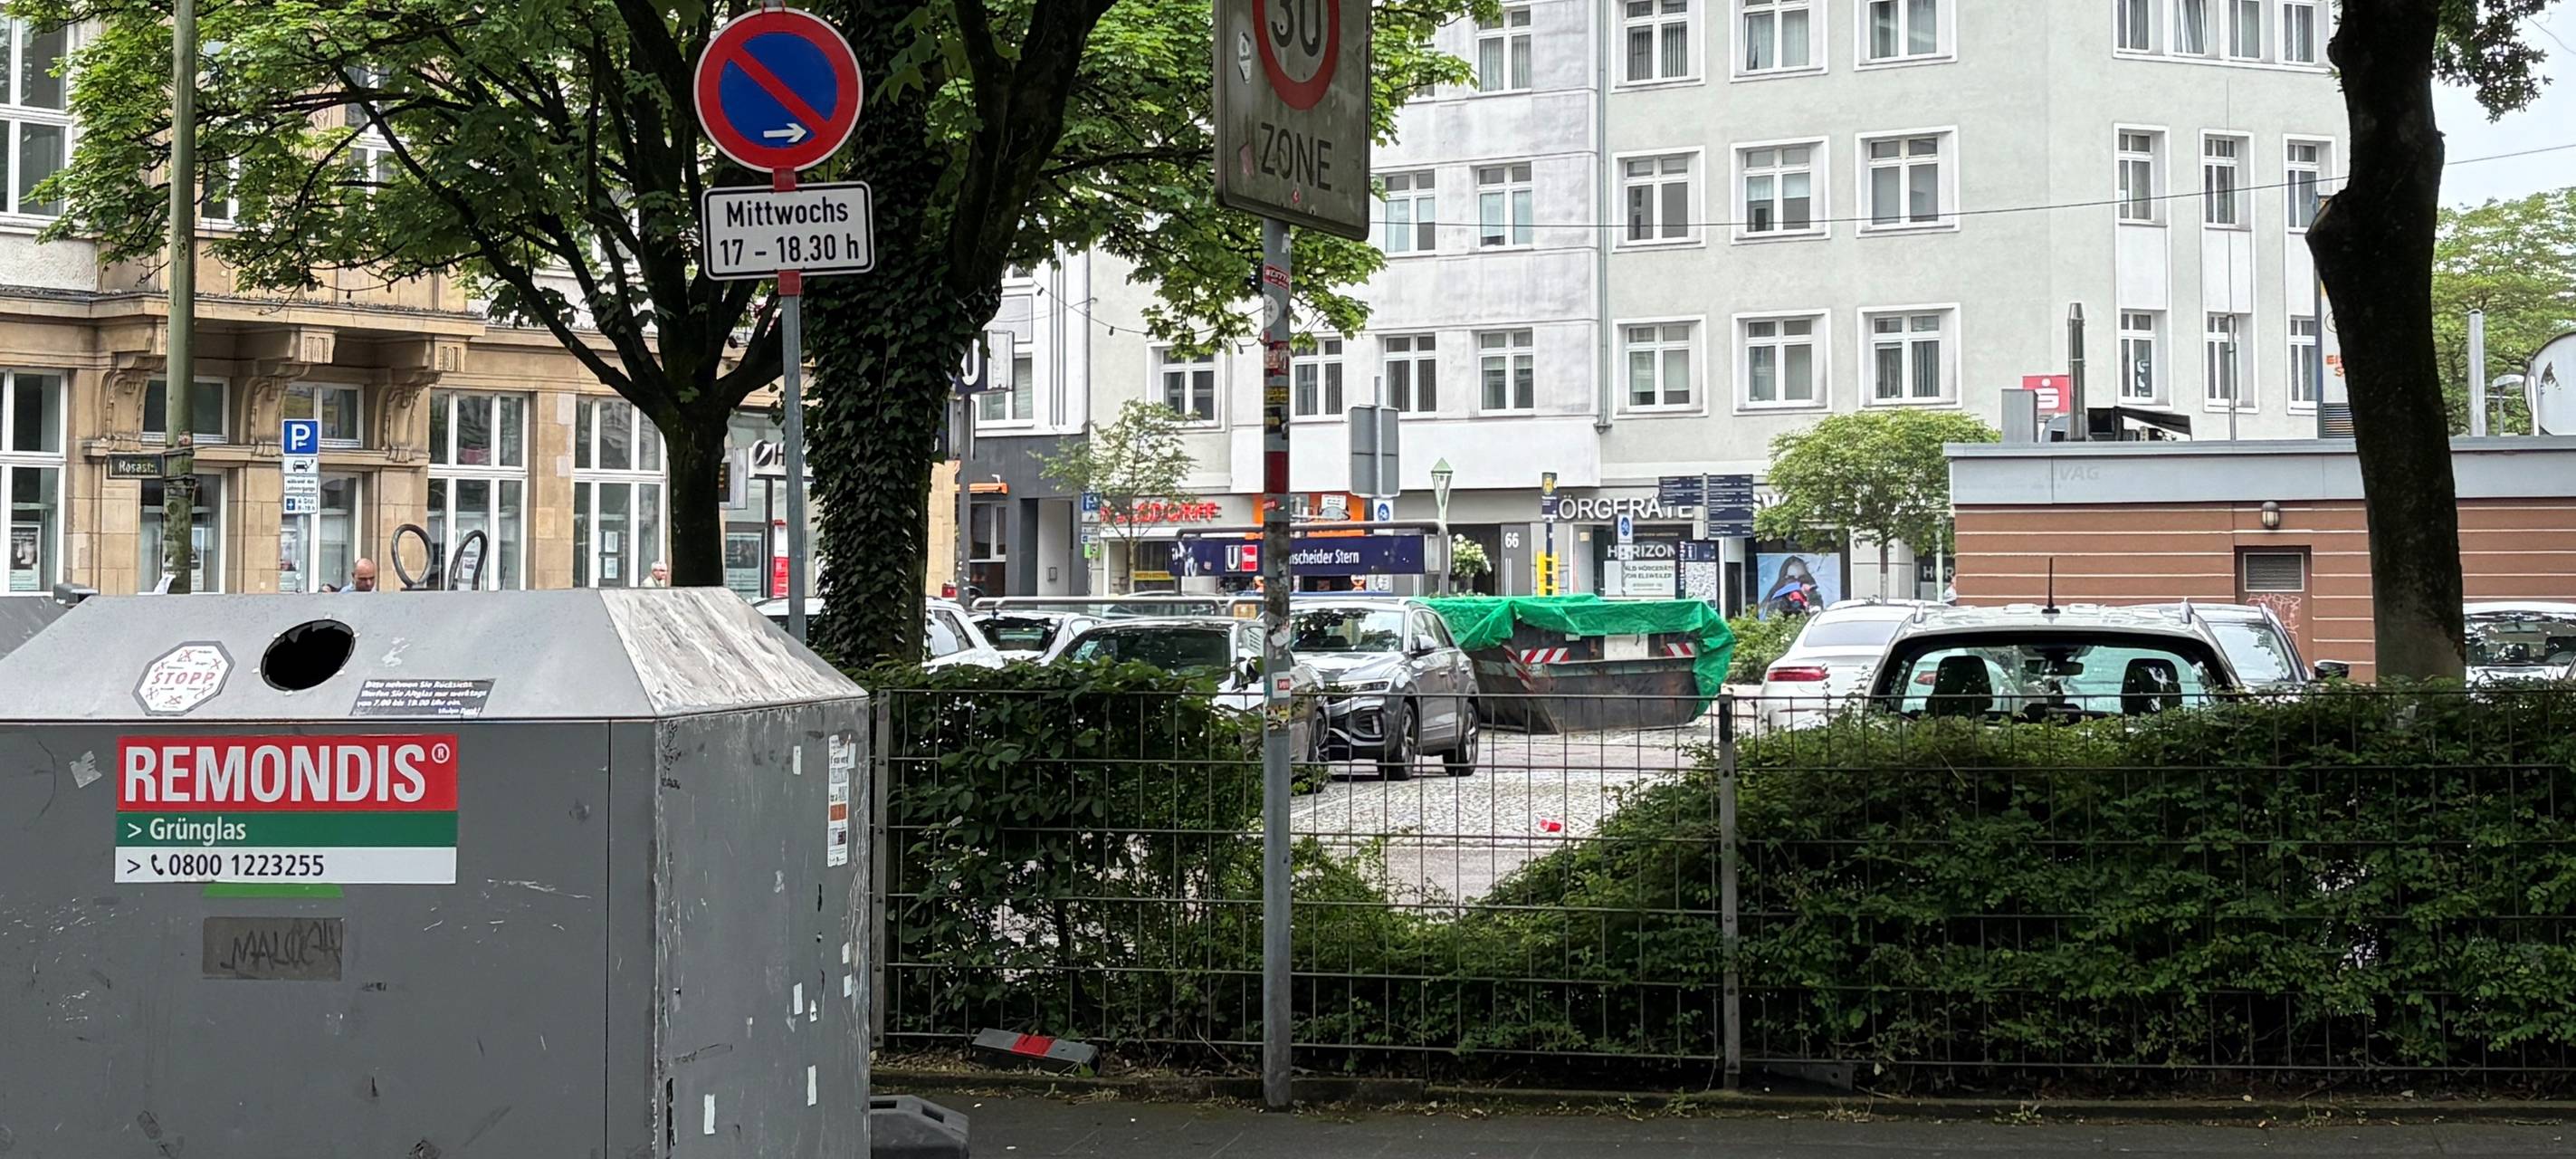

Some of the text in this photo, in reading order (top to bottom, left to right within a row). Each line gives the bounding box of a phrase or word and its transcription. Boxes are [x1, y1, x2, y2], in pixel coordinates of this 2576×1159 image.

[1261, 122, 1331, 191] ZONE
[726, 196, 849, 227] Mittwochs
[720, 238, 744, 266] 17
[776, 234, 836, 263] 18.30
[846, 233, 859, 259] h
[291, 423, 310, 451] P
[2053, 465, 2100, 481] VAG
[1558, 493, 1694, 520] ÖRGERÄE
[1504, 532, 1520, 549] 66
[1607, 545, 1676, 558] HRIZON
[1227, 546, 1239, 570] U
[1289, 549, 1334, 565] nscheider
[1335, 549, 1360, 564] Stern
[151, 672, 215, 685] STOPP
[149, 816, 246, 846] Grünglas
[167, 854, 222, 876] 0800
[231, 854, 325, 876] 1223255
